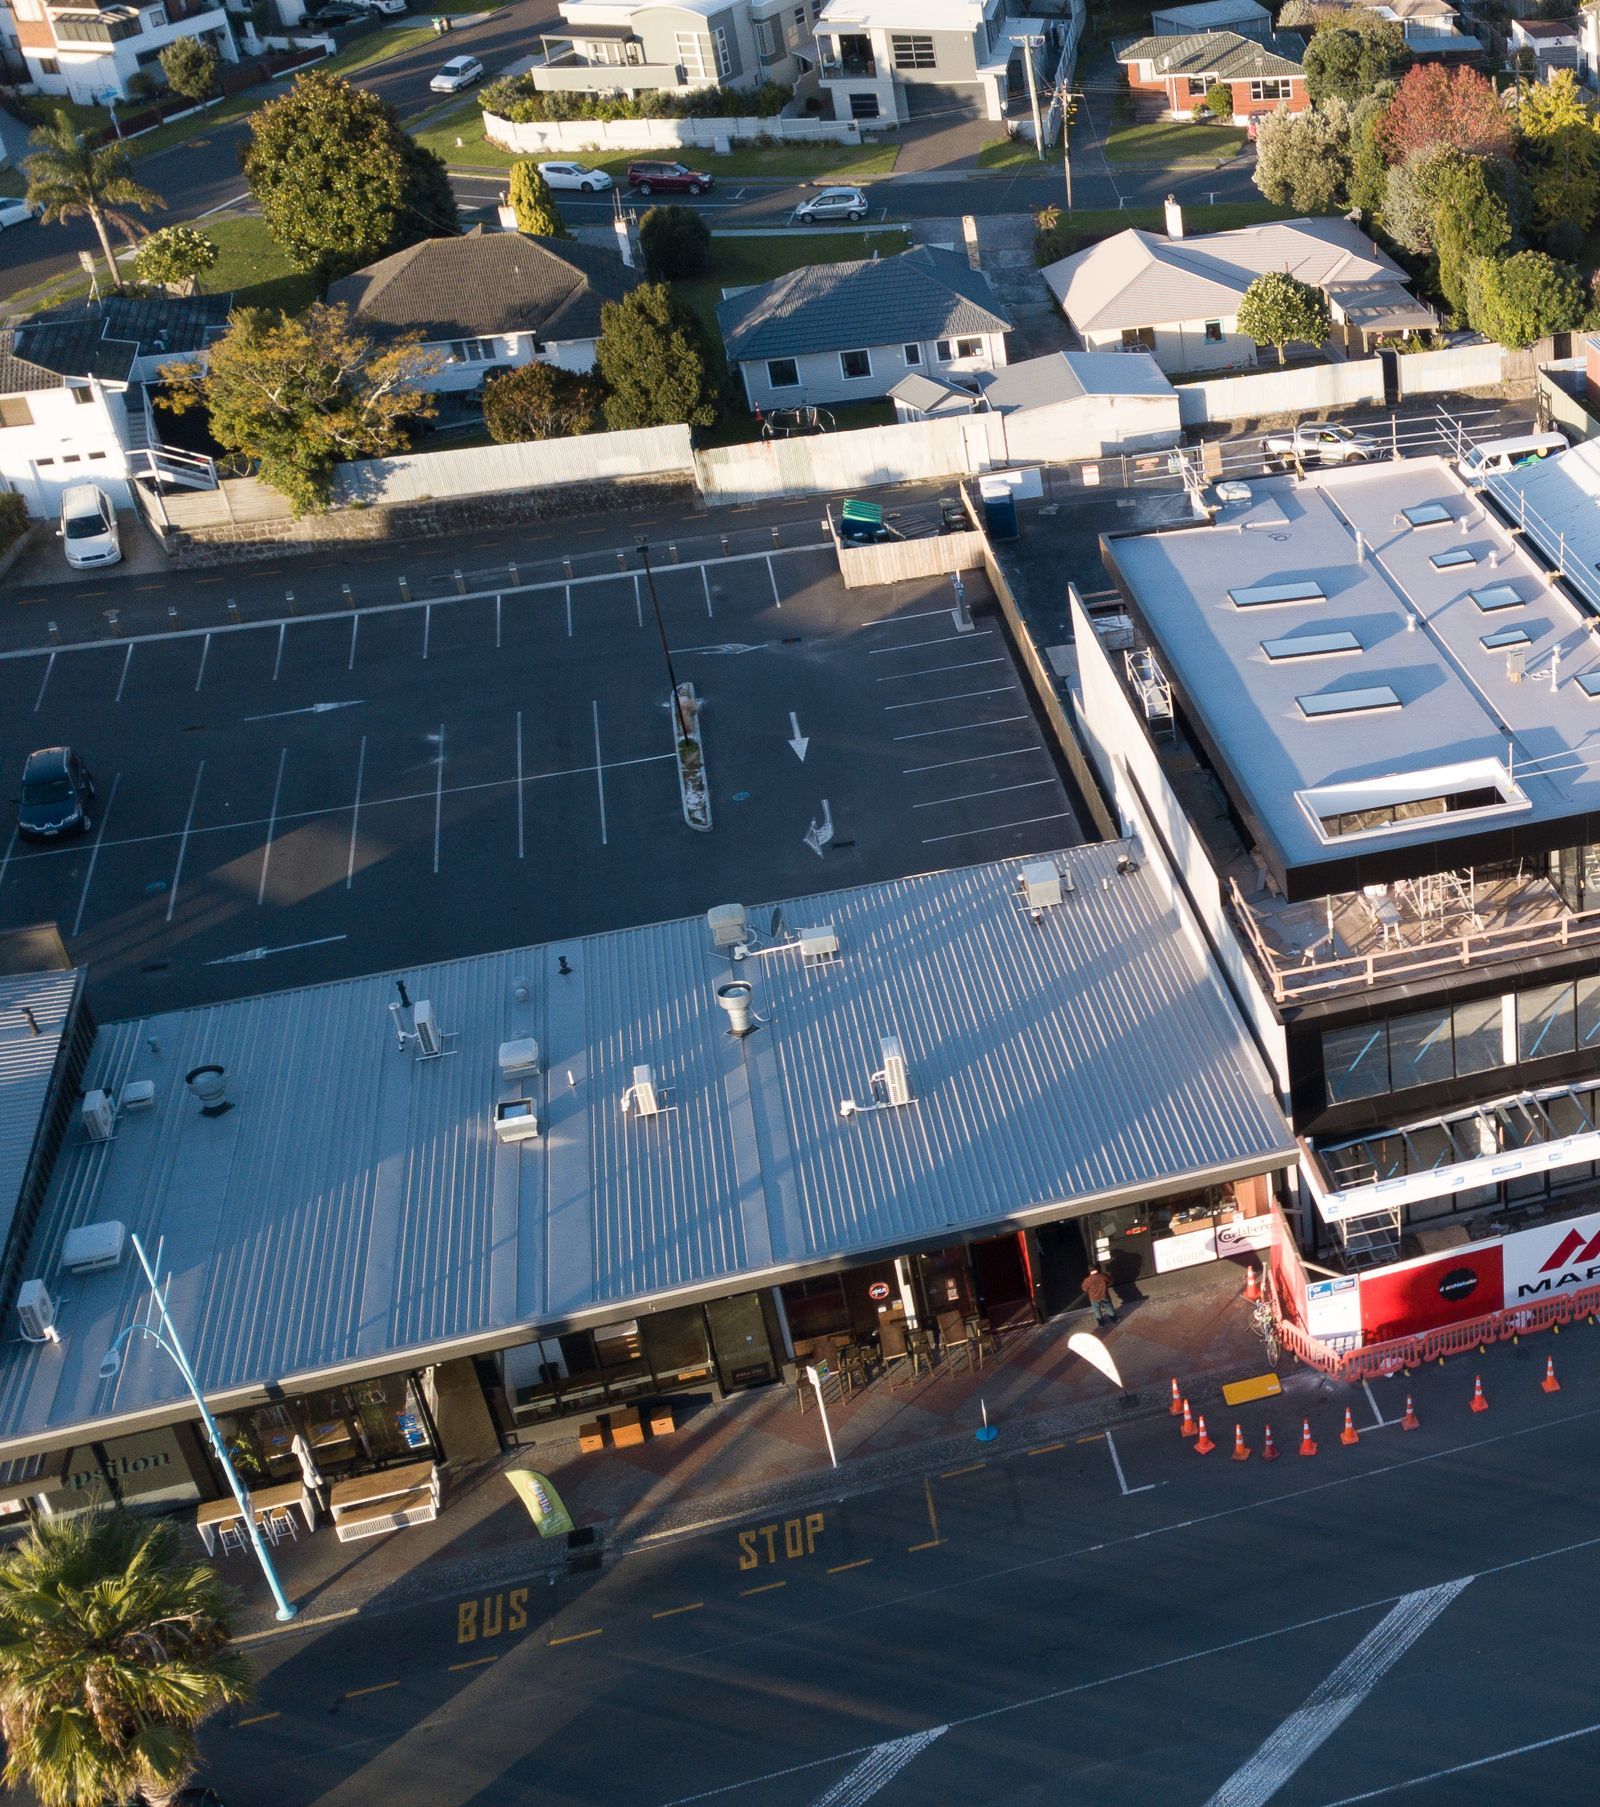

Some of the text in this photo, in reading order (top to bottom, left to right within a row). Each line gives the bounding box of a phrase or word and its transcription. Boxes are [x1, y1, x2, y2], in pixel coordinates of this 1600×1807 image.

[1309, 1284, 1322, 1294] For
[1310, 1289, 1331, 1299] Lease
[458, 1512, 824, 1645] BUS STOP
